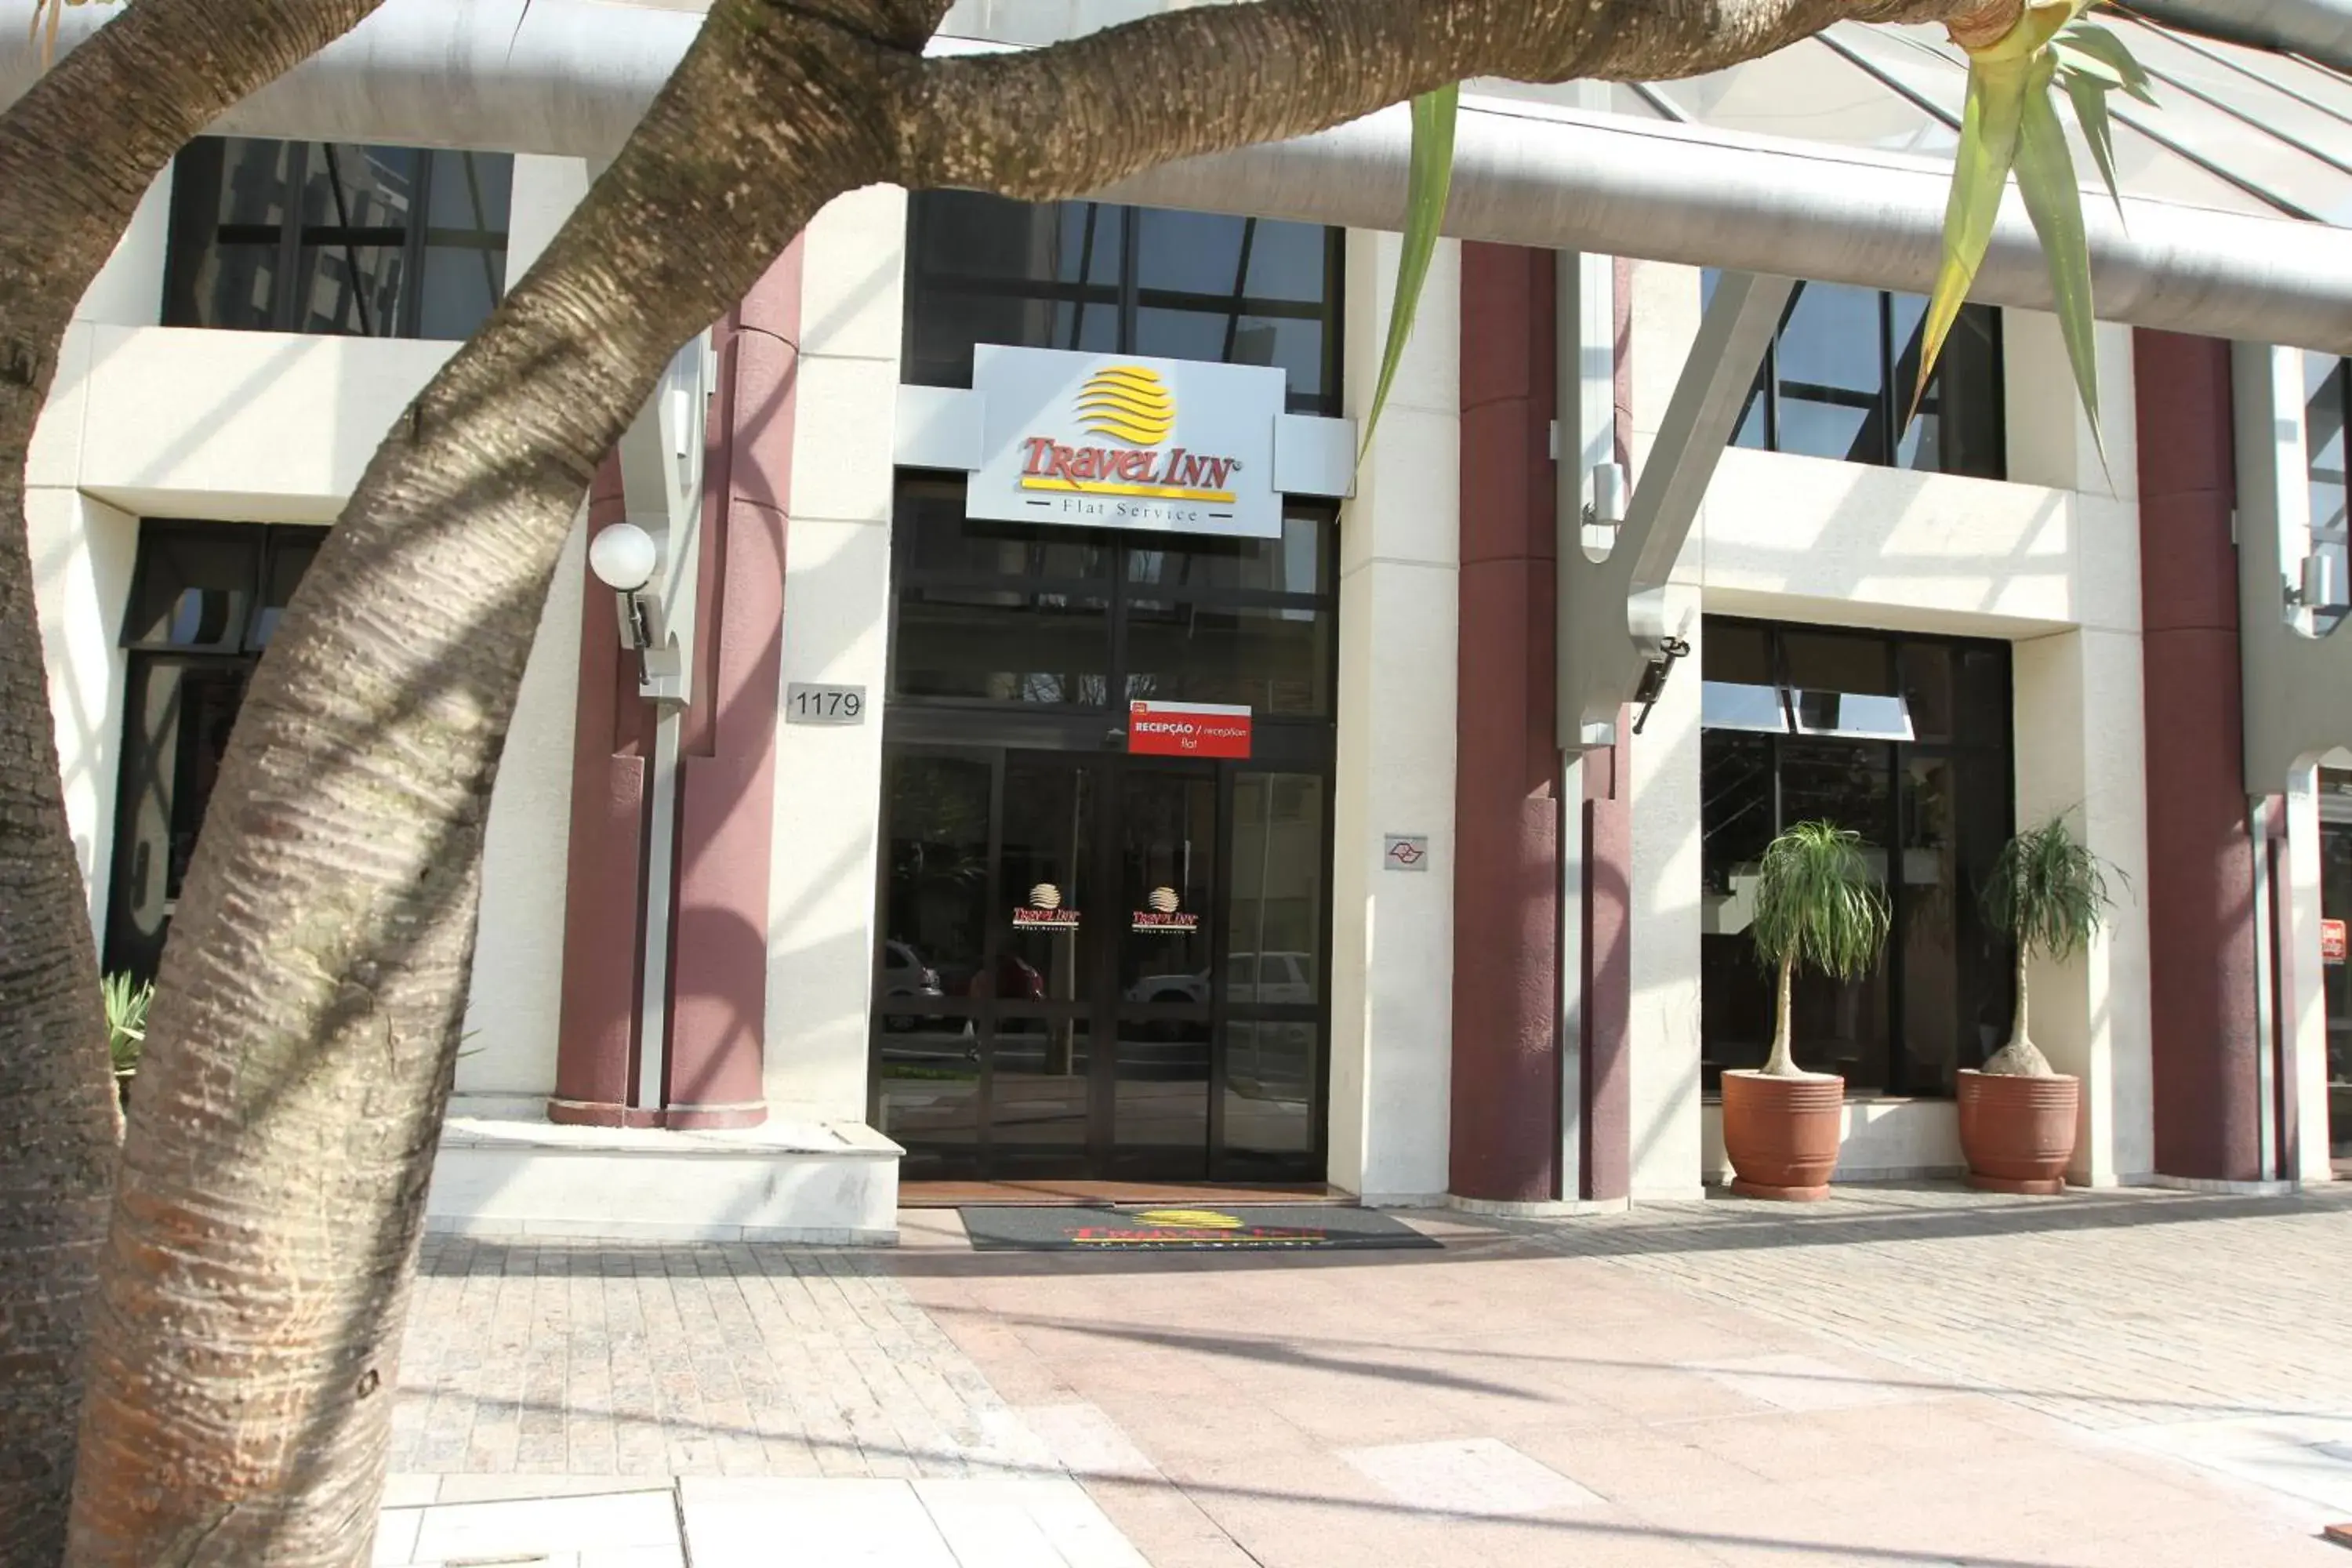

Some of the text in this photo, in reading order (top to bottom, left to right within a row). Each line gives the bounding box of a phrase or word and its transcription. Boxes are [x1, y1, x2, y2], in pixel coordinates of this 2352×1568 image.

[1160, 448, 1236, 489] INN
[1063, 498, 1199, 522] Flat Service
[796, 691, 861, 716] 1179
